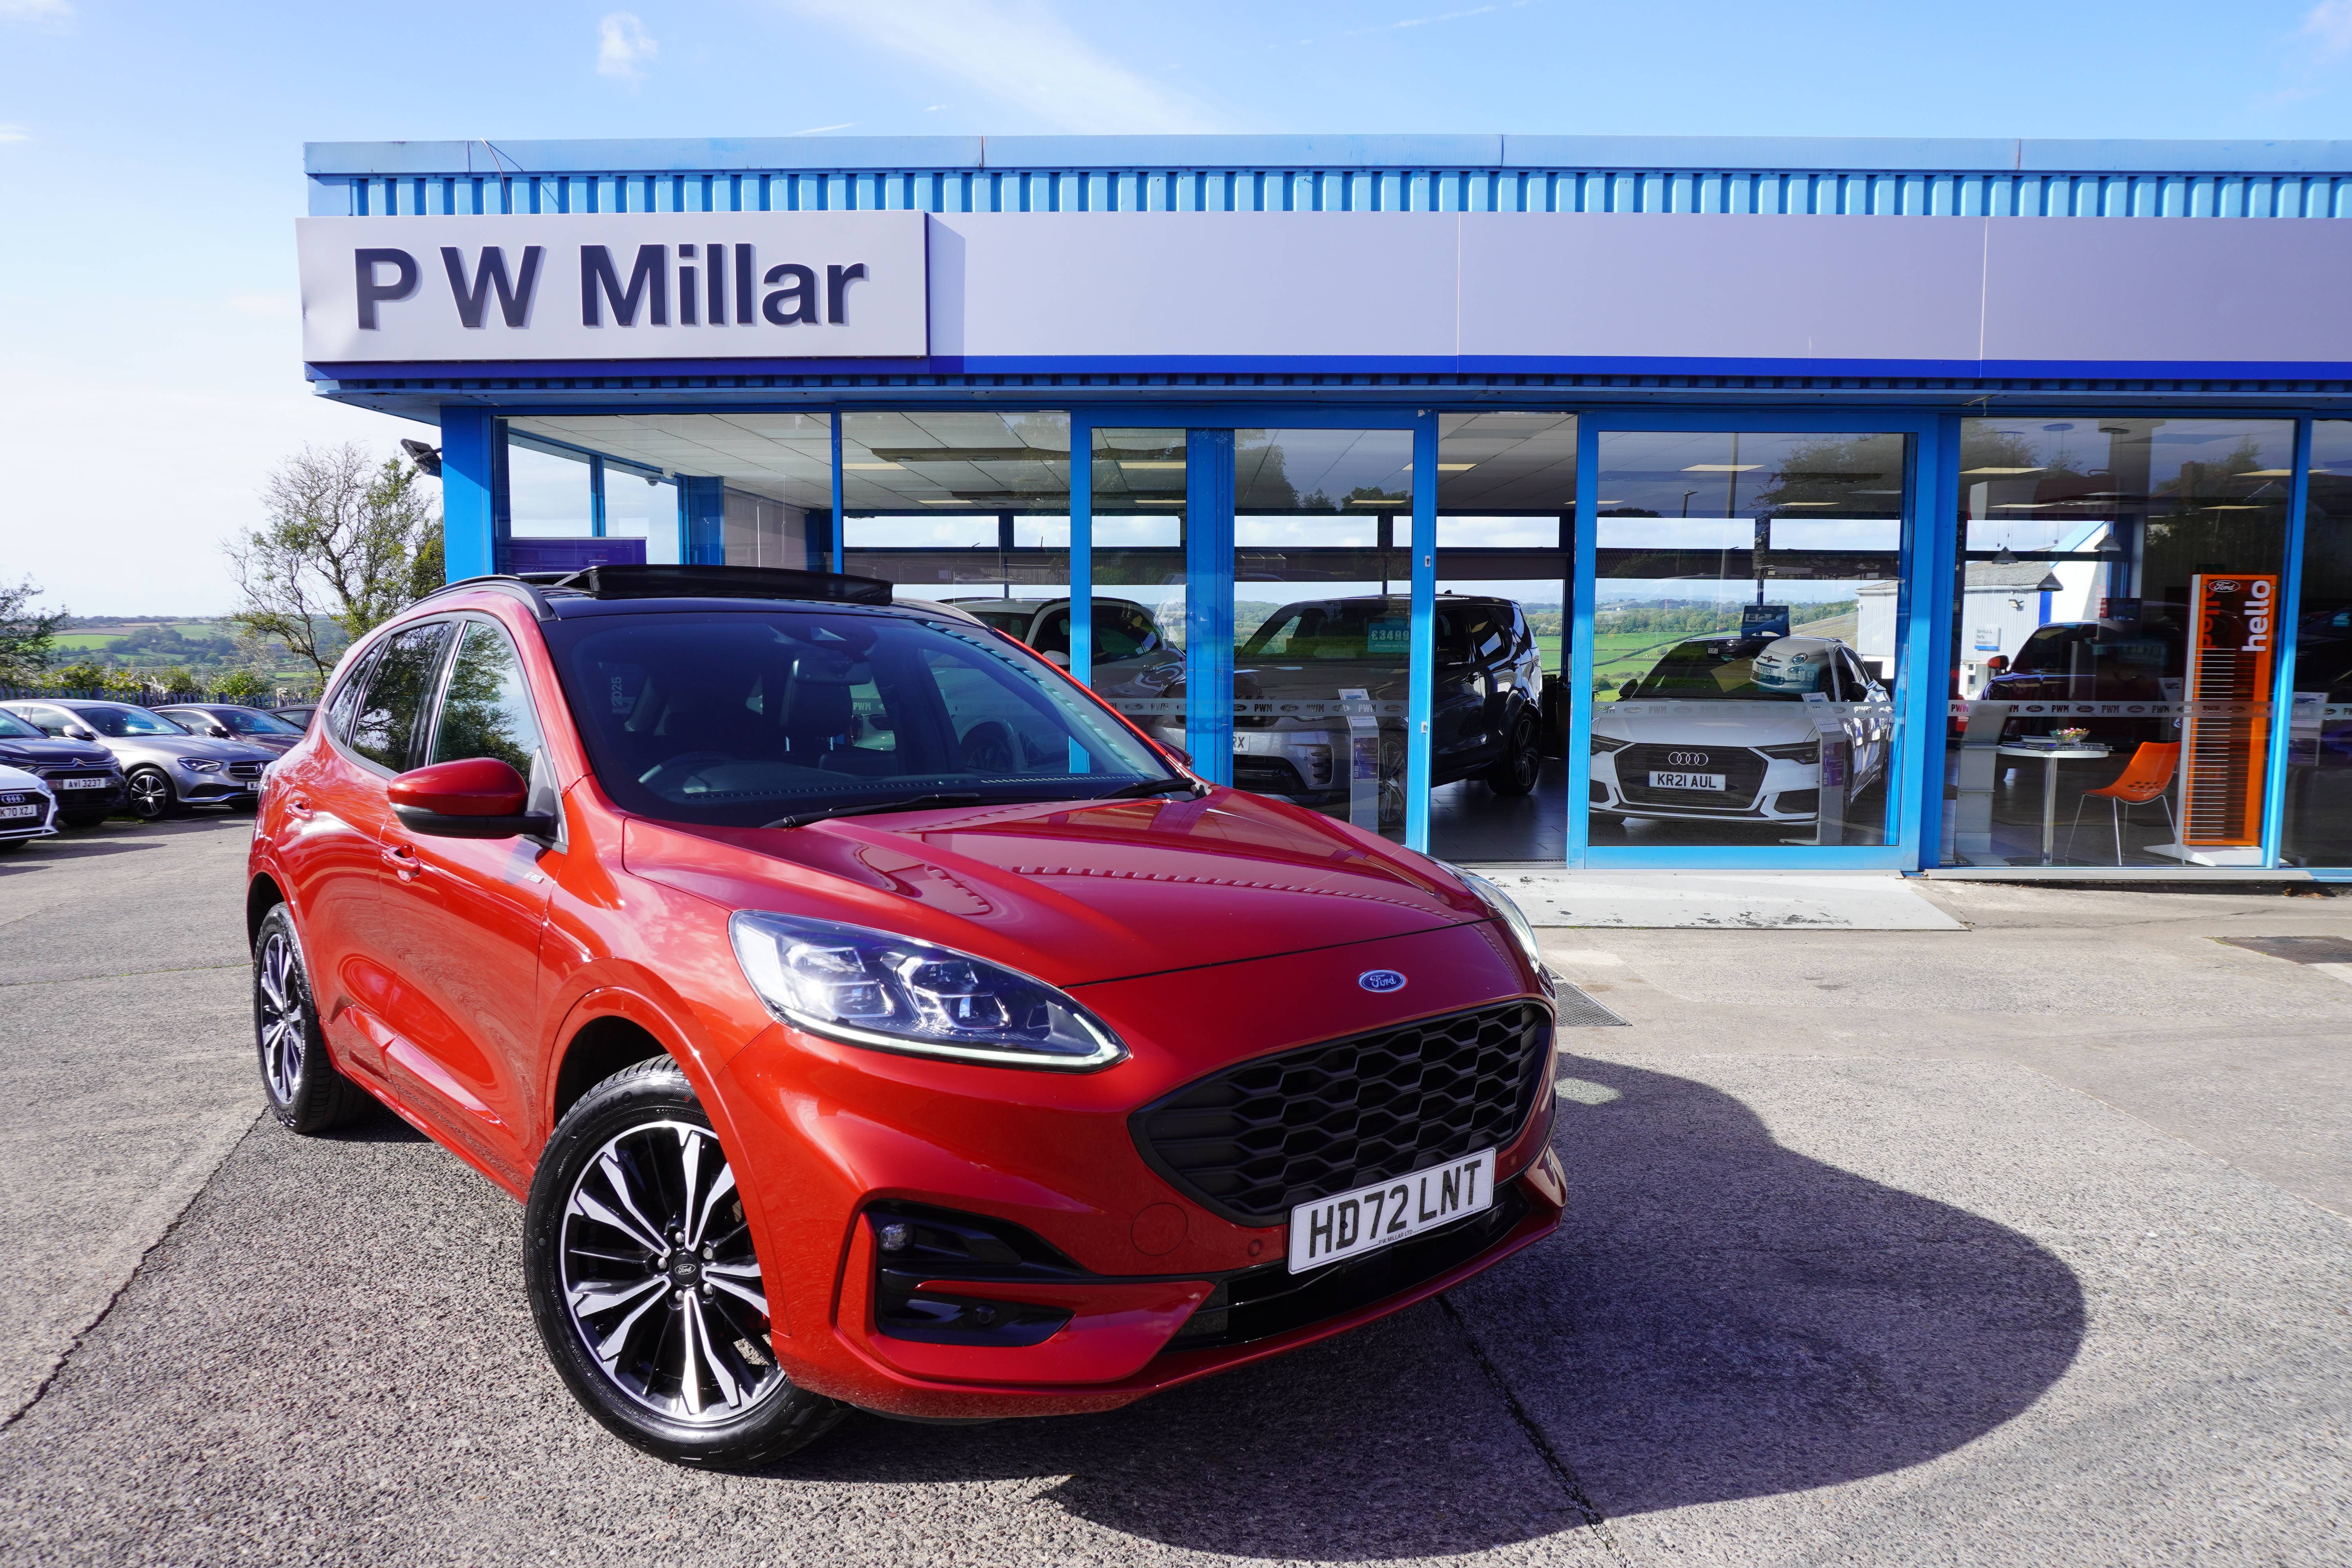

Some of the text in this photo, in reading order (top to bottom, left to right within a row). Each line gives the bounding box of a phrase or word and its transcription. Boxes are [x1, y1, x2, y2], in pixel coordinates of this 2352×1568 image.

[356, 243, 867, 329] P W Millar
[2214, 581, 2236, 590] Ford
[2241, 580, 2271, 652] hello
[853, 702, 871, 710] PWM
[1254, 704, 1272, 712] PWM
[1358, 704, 1377, 713] PWM
[1648, 706, 1667, 714] PWM
[1951, 704, 1969, 712] PWM
[2051, 704, 2069, 713] PWM
[2102, 705, 2120, 713] PWM
[2152, 705, 2169, 713] PWM
[82, 779, 101, 788] 3237
[1657, 773, 1717, 788] KR21 AUL
[20, 806, 33, 816] XZJ
[1370, 974, 1396, 988] Ford
[1309, 1159, 1482, 1259] HD72 LNT
[678, 1265, 692, 1274] Ford
